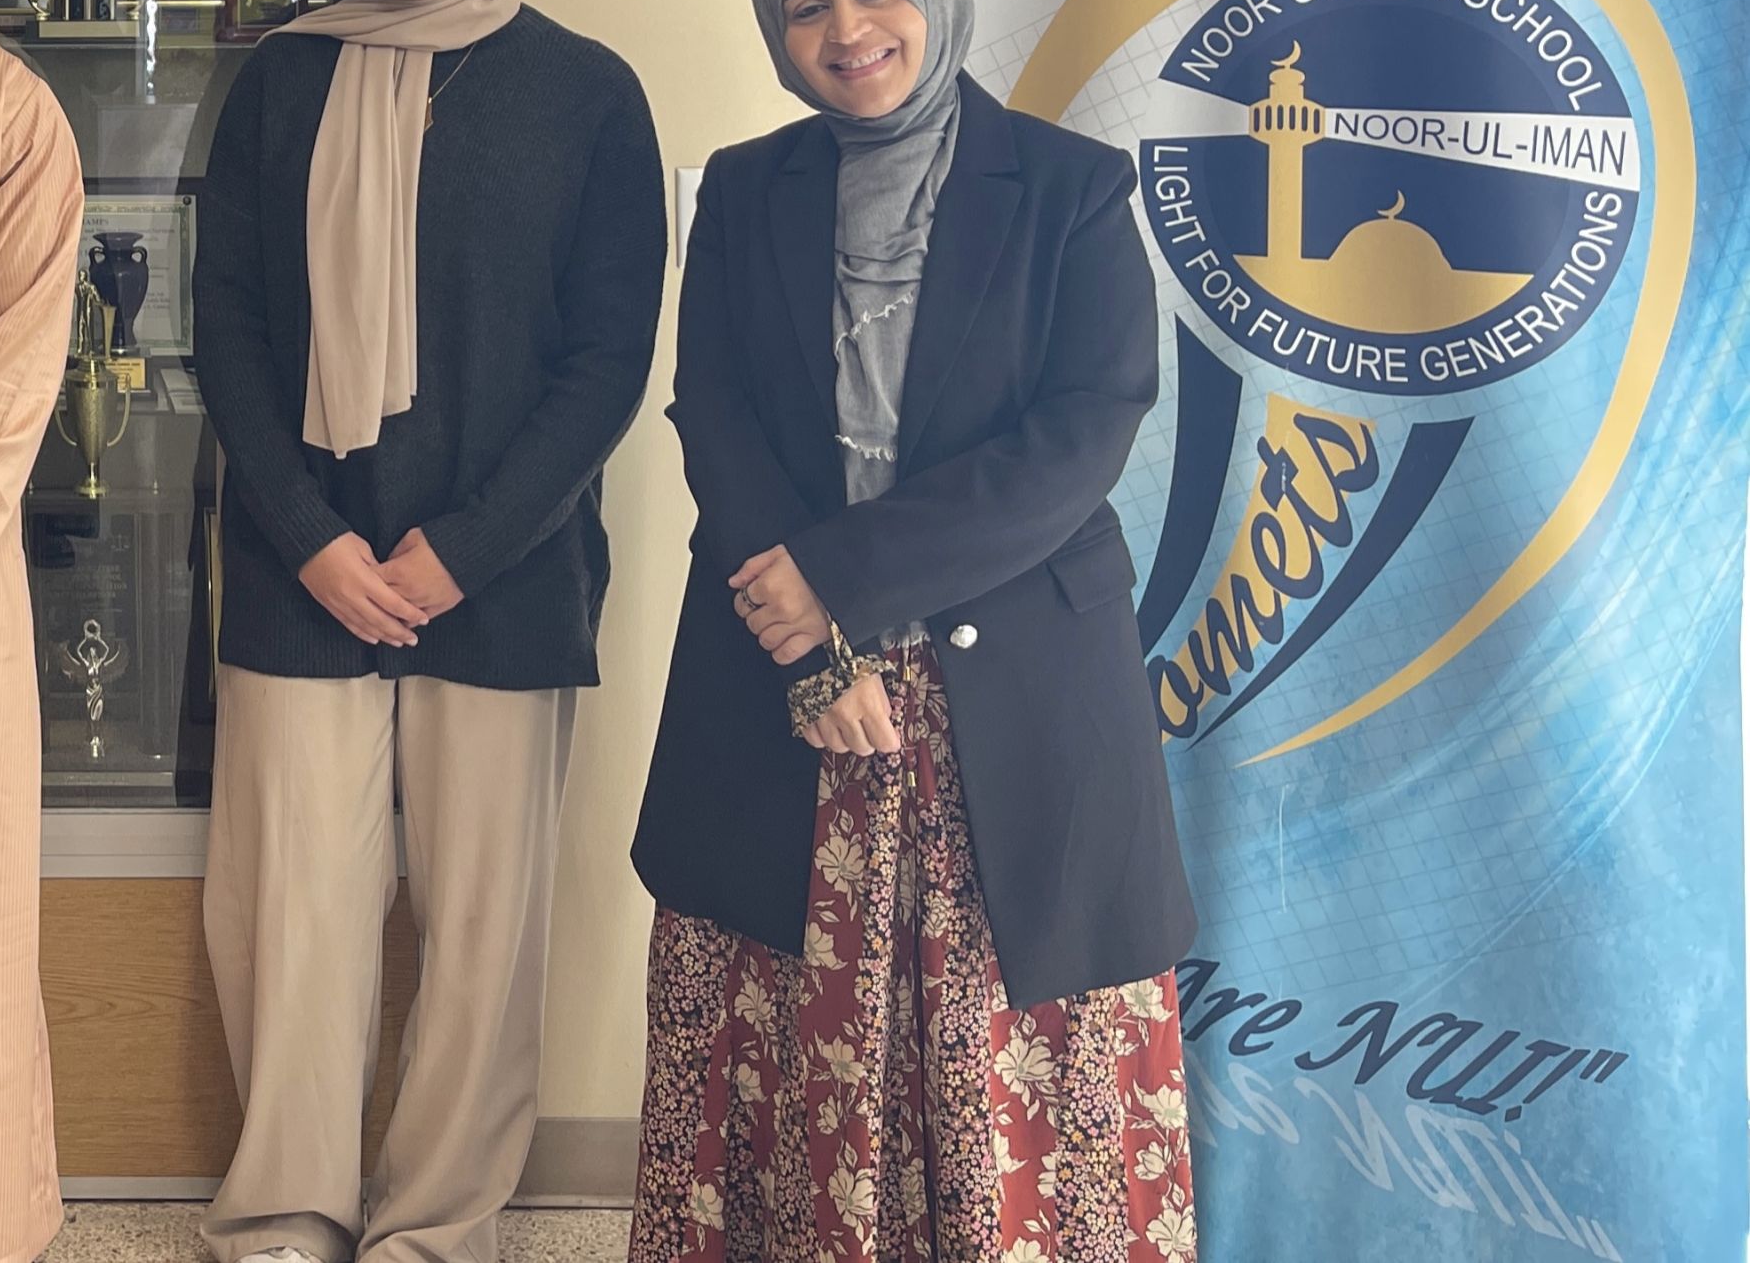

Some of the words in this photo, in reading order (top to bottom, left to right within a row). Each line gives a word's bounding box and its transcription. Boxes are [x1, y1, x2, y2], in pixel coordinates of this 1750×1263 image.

[1152, 144, 1207, 245] LIGHT
[1185, 247, 1252, 324] FOR
[1247, 308, 1410, 384] FUTURE
[1419, 190, 1624, 382] GENERATIONS
[1333, 111, 1628, 177] NOOR-UL-IMAN
[1147, 412, 1380, 738] omets
